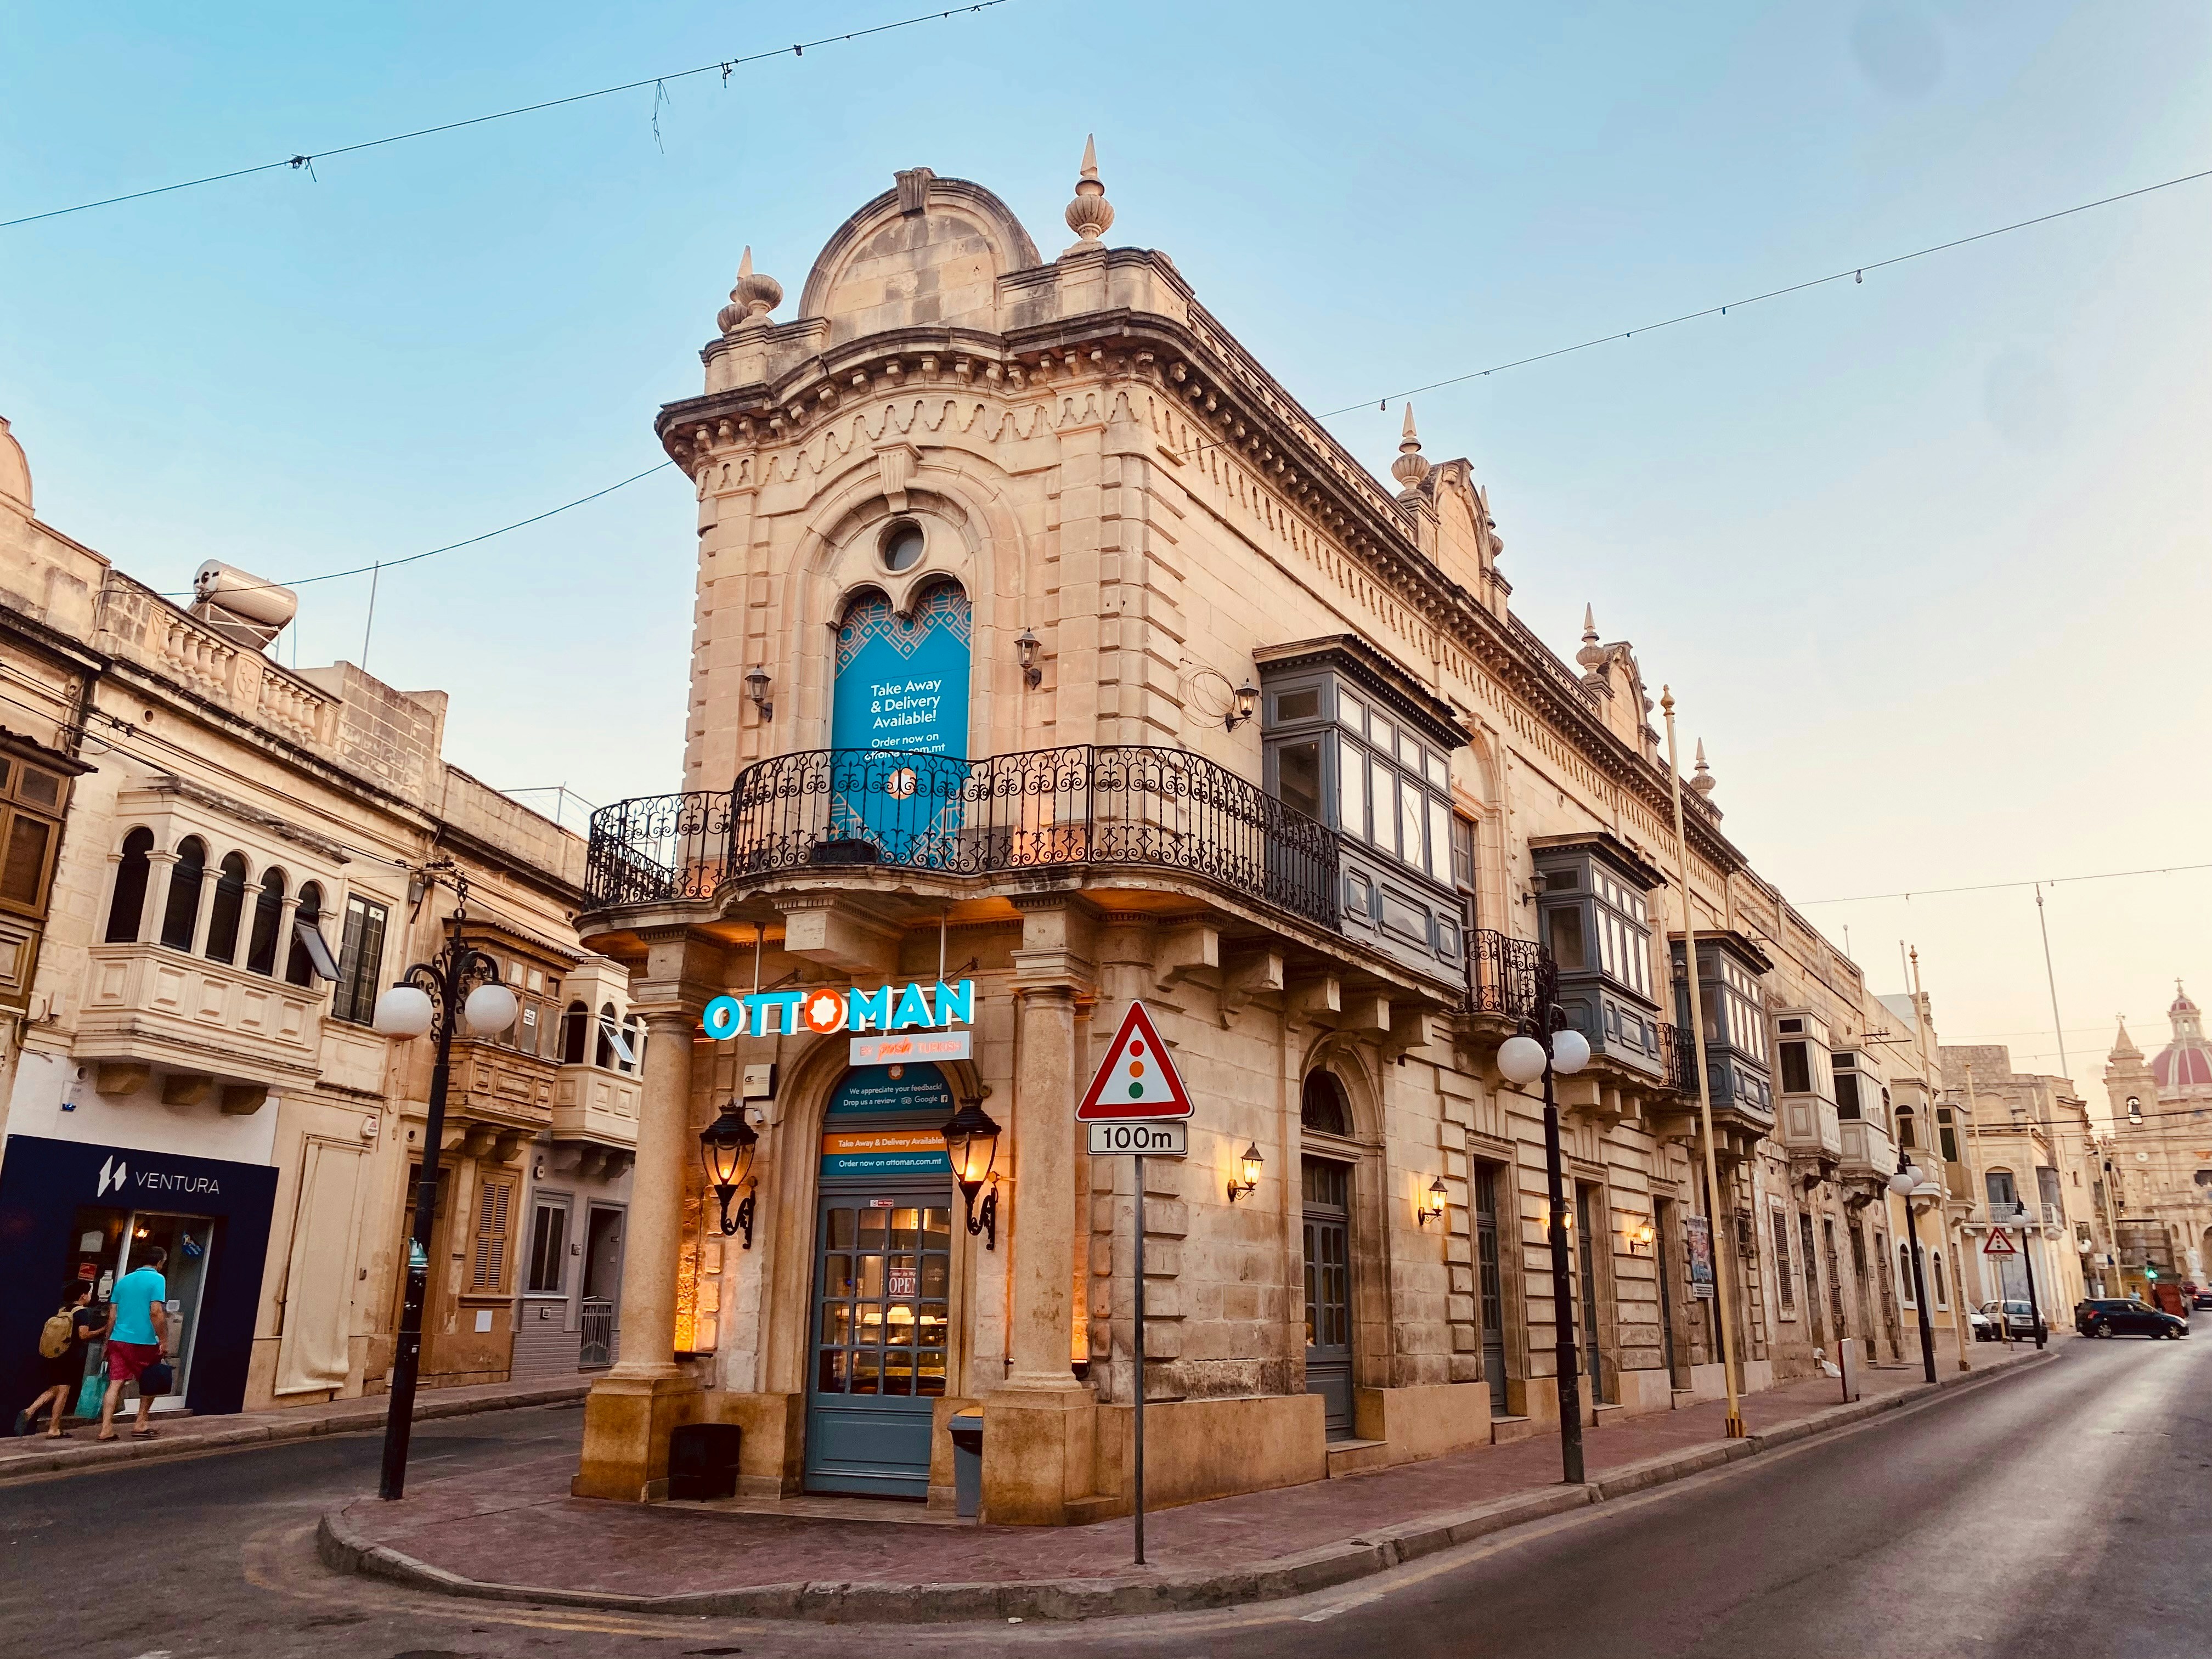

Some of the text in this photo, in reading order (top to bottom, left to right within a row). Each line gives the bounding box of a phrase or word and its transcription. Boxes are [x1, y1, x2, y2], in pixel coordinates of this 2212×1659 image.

[871, 680, 942, 697] Take Away
[871, 696, 941, 713] & Delivery
[872, 709, 936, 729] Available!
[871, 737, 900, 748] Order
[902, 735, 924, 744] now
[703, 979, 975, 1041] OTTOMAN
[918, 1040, 962, 1054] TURKISH
[861, 1086, 893, 1096] appreciate
[911, 1083, 943, 1092] feedback!
[915, 1095, 938, 1103] Google
[855, 1139, 873, 1148] Away
[882, 1138, 911, 1147] Delivery
[911, 1136, 945, 1145] Available!
[1103, 1126, 1172, 1149] 100m
[136, 1171, 219, 1194] VENTURA
